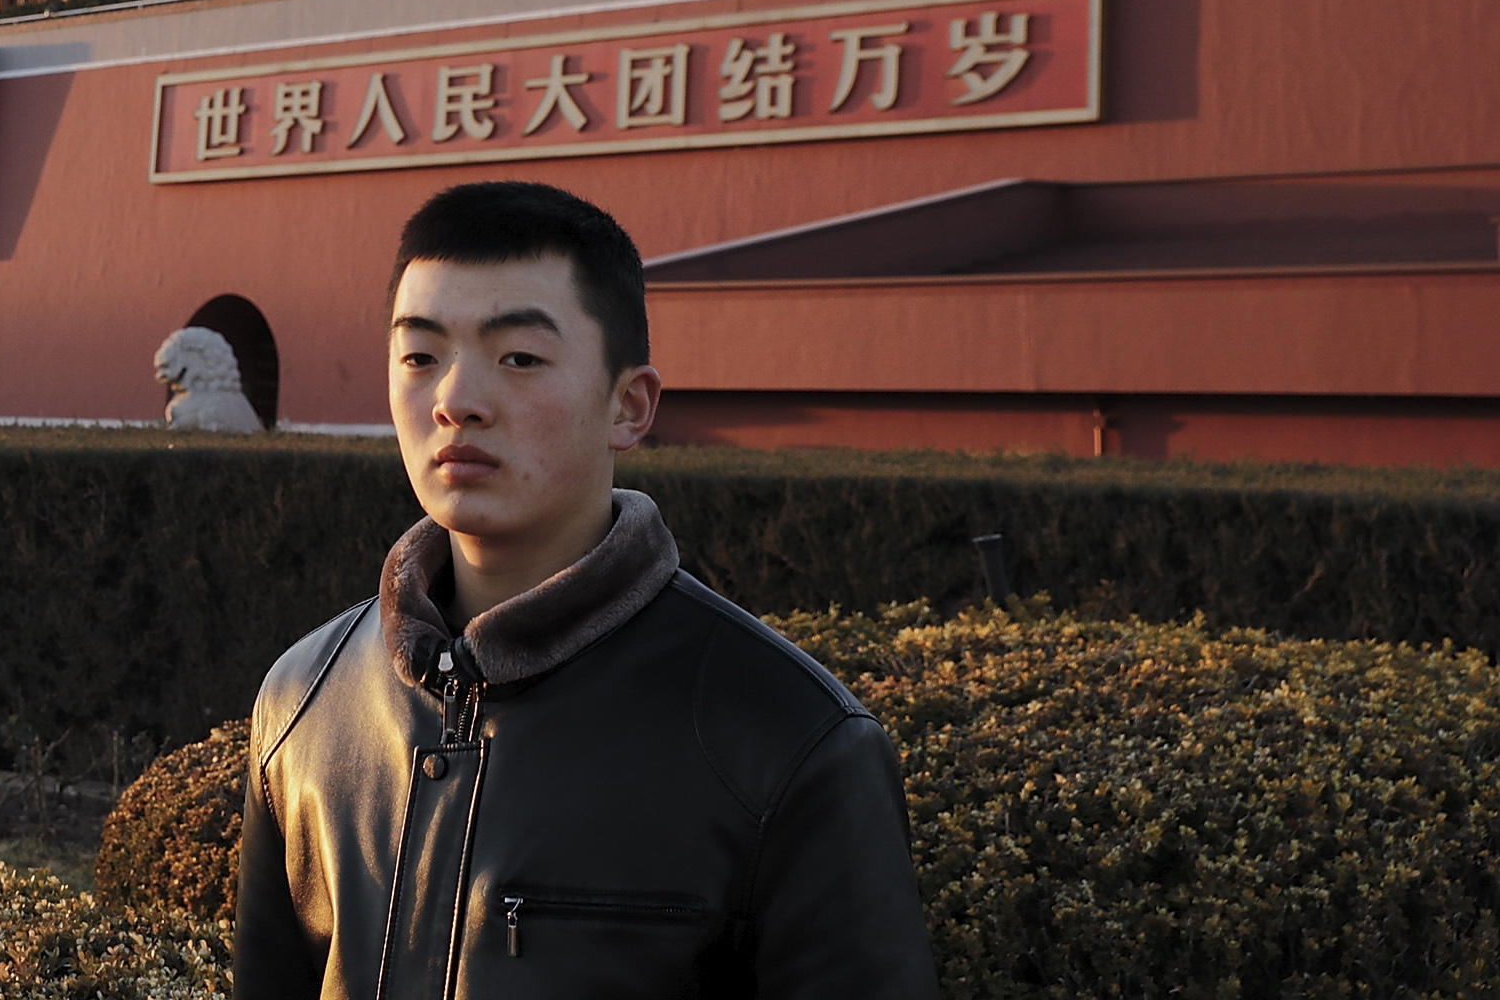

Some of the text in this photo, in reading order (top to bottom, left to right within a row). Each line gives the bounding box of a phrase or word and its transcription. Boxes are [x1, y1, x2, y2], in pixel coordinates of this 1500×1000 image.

[193, 10, 1031, 162] 世界人民大团结万岁
